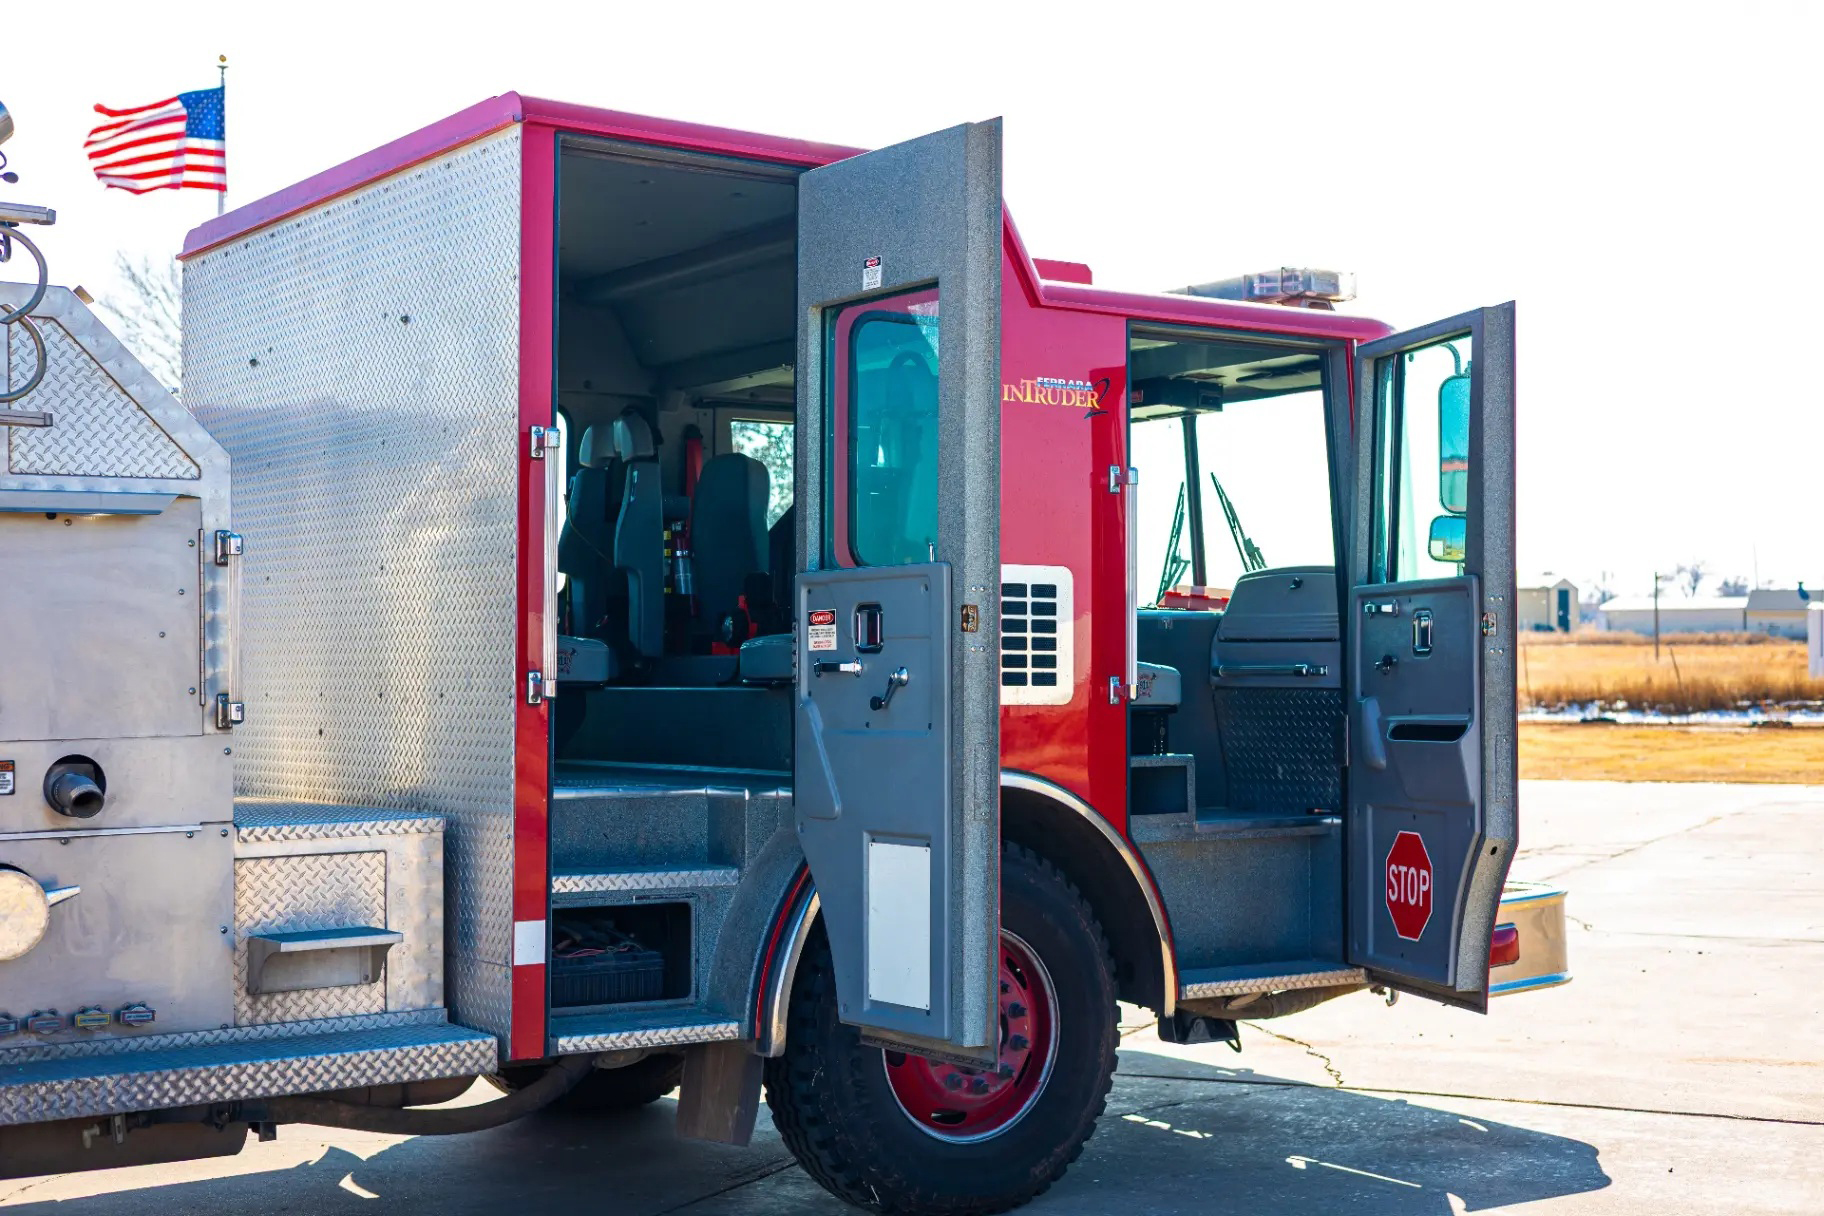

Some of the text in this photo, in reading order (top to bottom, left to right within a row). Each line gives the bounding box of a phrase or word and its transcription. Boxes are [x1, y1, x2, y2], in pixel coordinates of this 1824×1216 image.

[1002, 378, 1100, 409] INTRUDER
[1036, 376, 1093, 391] FERRARA
[1388, 863, 1430, 907] STOP
